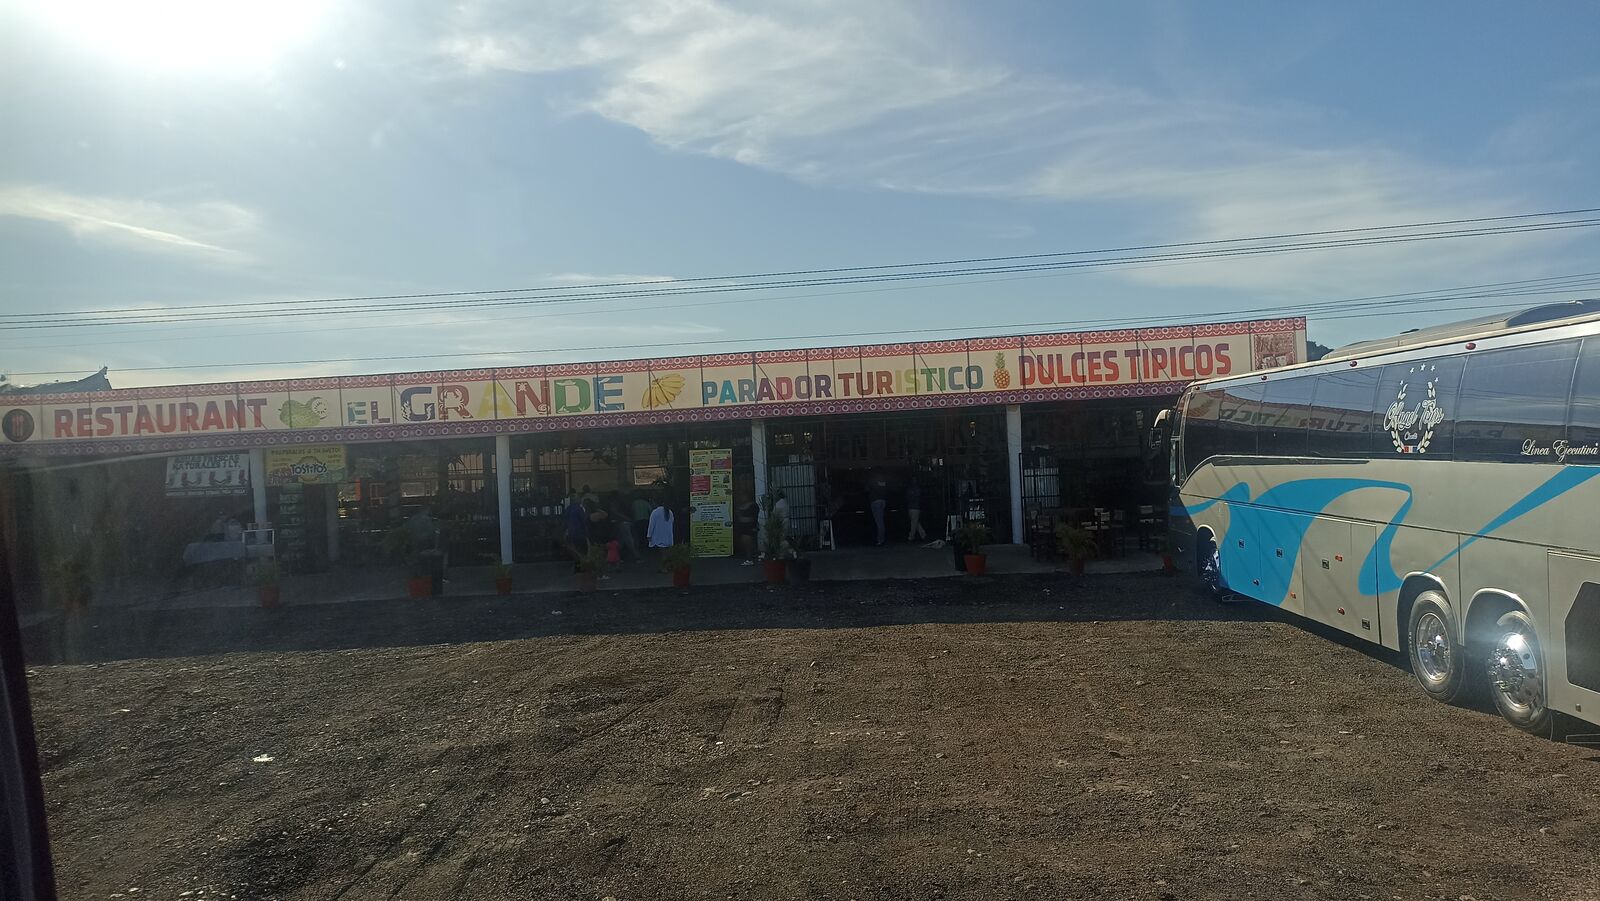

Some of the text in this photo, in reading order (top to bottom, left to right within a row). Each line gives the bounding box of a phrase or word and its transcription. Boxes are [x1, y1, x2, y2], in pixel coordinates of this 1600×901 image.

[702, 364, 984, 405] PARADOR TURISTICO
[1018, 343, 1231, 386] DULCES TIPICOS
[54, 398, 267, 438] RESTAURANT
[347, 375, 625, 425] EL GRANDE
[1552, 440, 1599, 462] Ejecutiva
